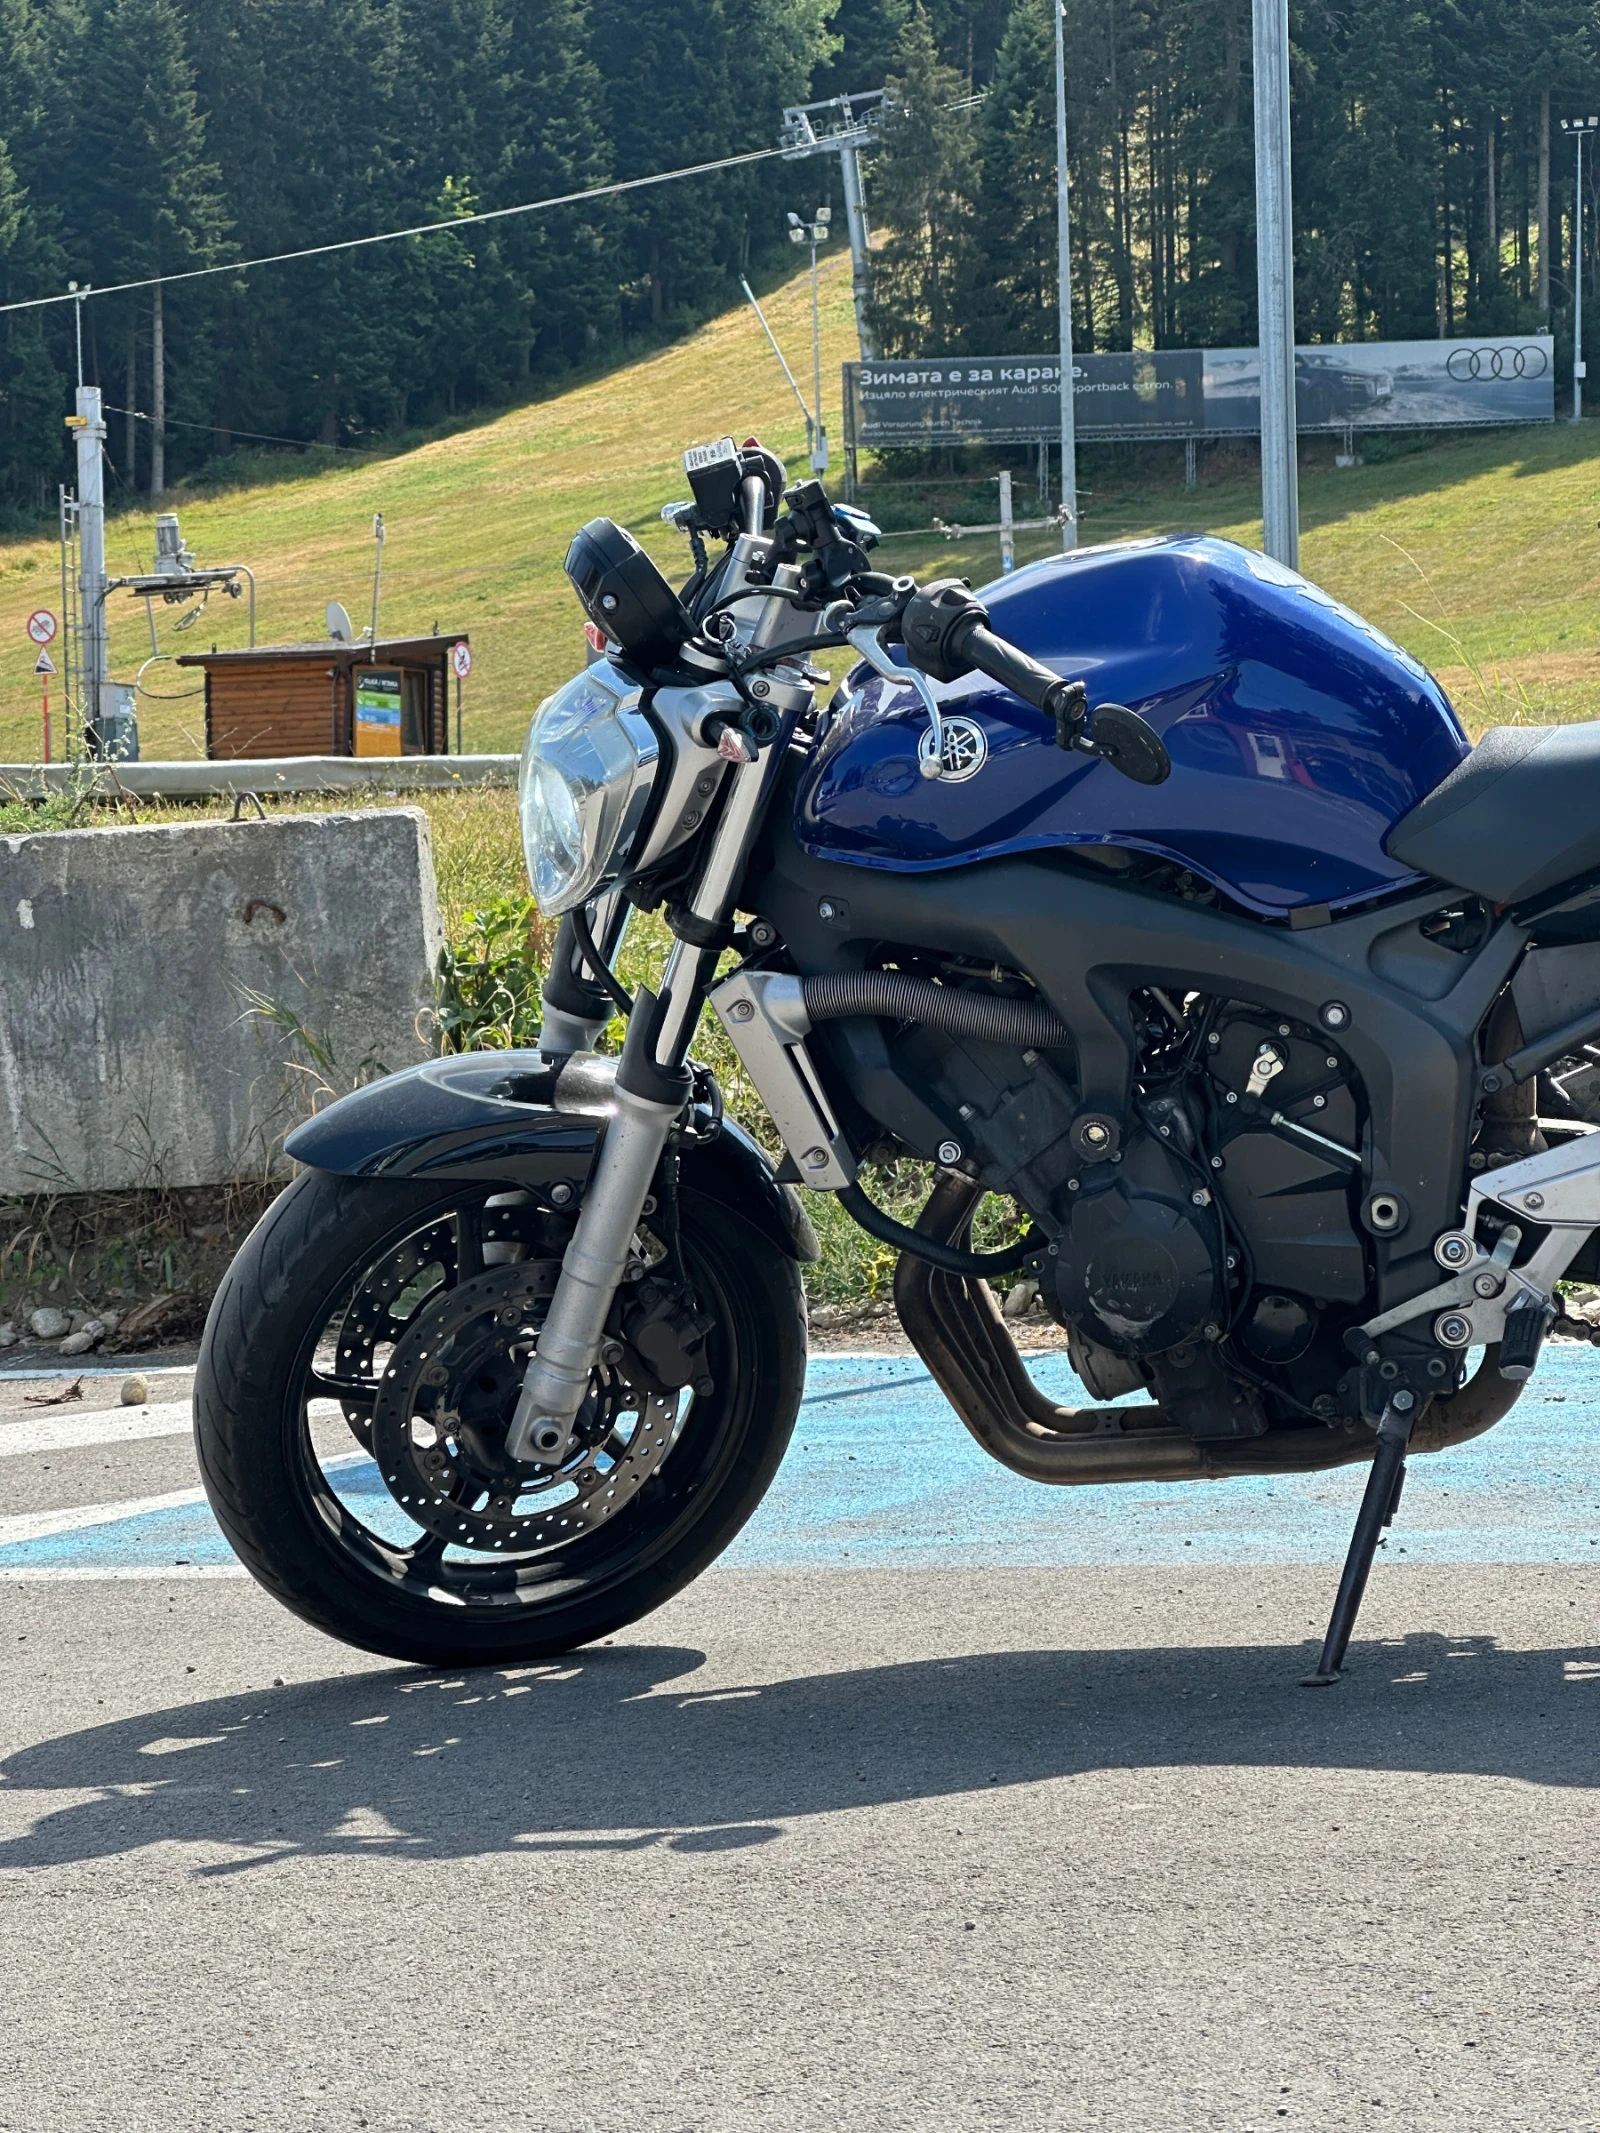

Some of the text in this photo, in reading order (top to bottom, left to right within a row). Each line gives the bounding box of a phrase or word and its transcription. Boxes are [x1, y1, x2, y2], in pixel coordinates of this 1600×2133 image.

[859, 370, 942, 385] Зимата
[949, 371, 962, 382] е
[968, 369, 993, 382] за
[860, 390, 906, 400] Изцяло
[908, 387, 1008, 398] електрическият
[1011, 385, 1038, 394] Audi
[862, 421, 880, 429] Audi
[882, 420, 925, 430] Vorsprung
[952, 417, 983, 425] Technik
